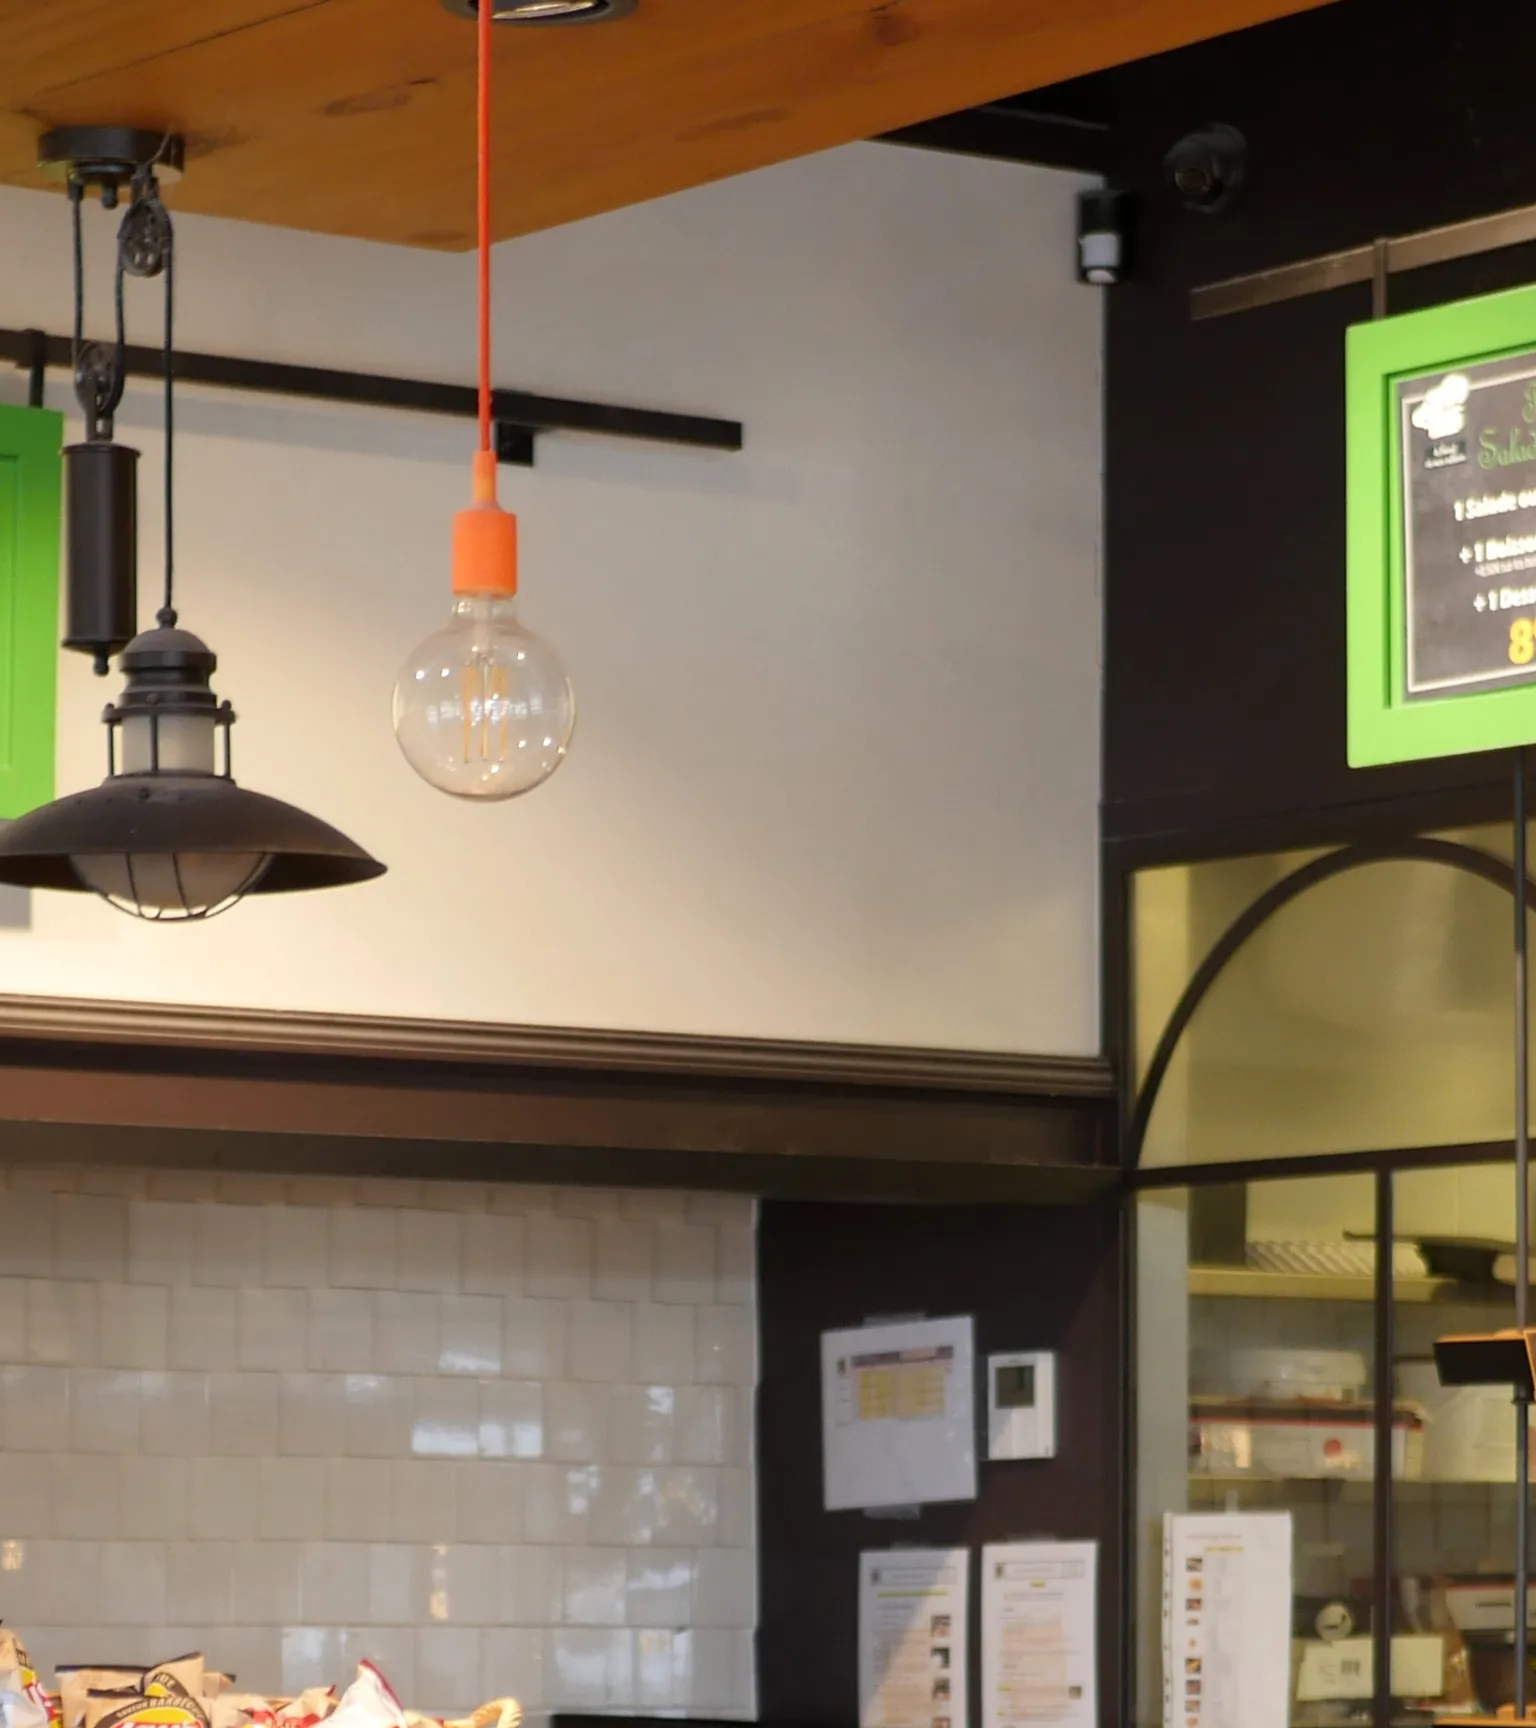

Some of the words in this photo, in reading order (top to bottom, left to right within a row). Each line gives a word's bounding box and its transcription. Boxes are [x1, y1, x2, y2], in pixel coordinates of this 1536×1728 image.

[1454, 501, 1464, 521] 1
[1465, 492, 1517, 519] Salade
[1474, 543, 1484, 562] 1
[1488, 590, 1498, 611] 1
